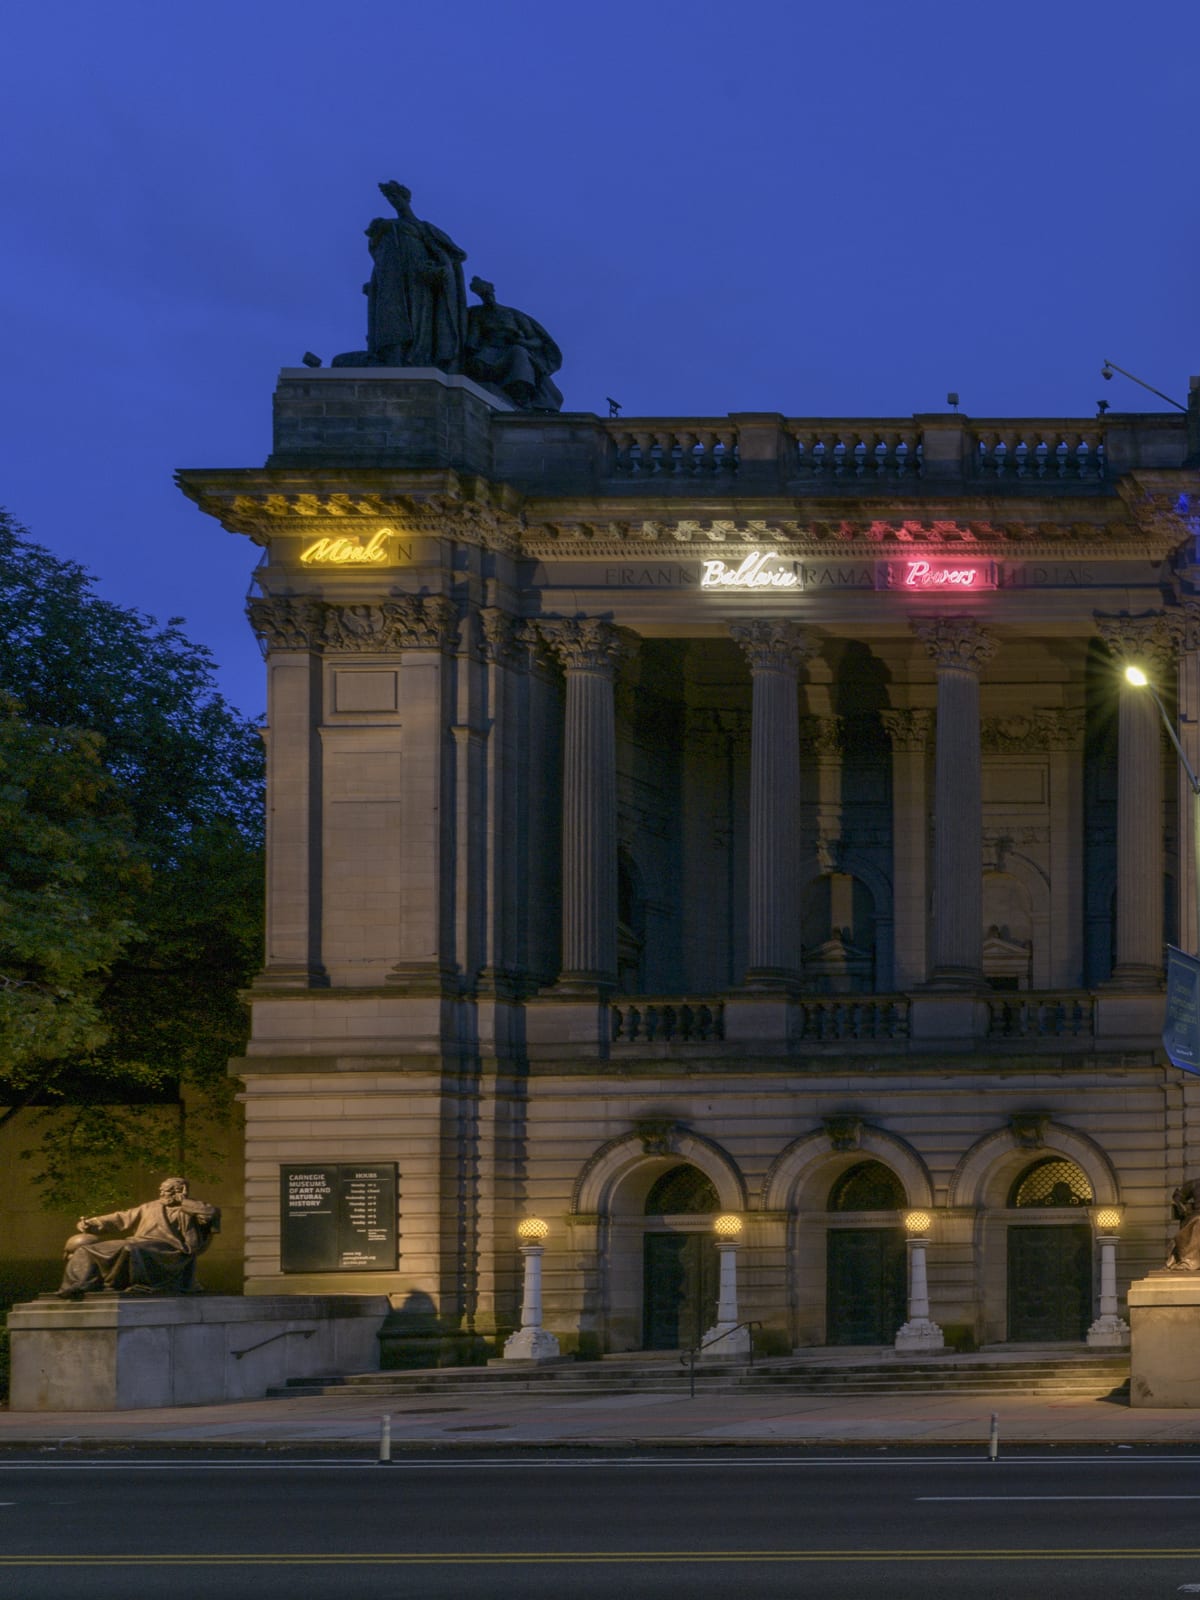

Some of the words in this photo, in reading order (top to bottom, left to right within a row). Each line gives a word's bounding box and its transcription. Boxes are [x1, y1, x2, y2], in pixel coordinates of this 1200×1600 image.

[300, 528, 393, 564] Monk
[606, 567, 700, 584] FRANK
[701, 552, 797, 587] Baldwin
[907, 561, 976, 587] Powers
